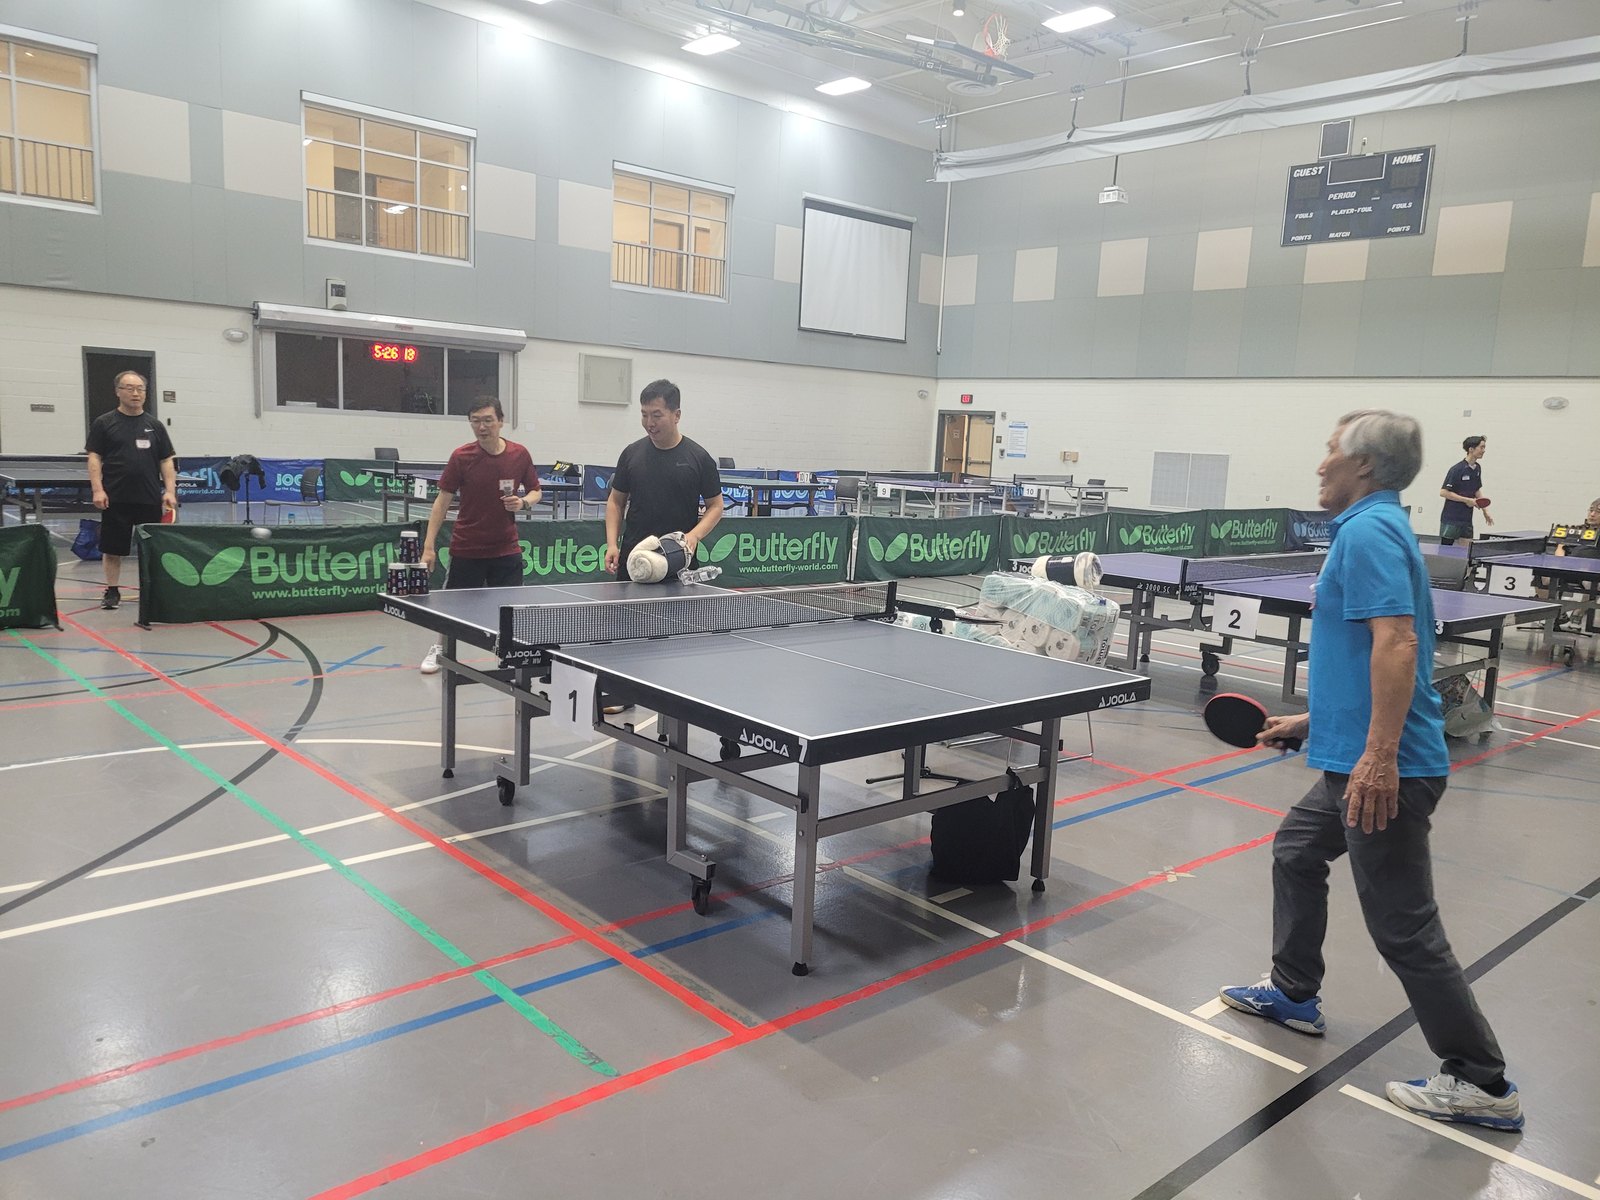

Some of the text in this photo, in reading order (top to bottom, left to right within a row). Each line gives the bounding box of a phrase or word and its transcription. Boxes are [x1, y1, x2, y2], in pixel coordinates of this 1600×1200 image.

[1392, 153, 1424, 165] HOME
[1293, 166, 1325, 178] GUEST
[1328, 191, 1356, 200] PERIOD
[1331, 206, 1372, 215] PLAYER-FOUL
[1387, 225, 1411, 233] POINTS
[881, 487, 887, 496] 9
[1026, 488, 1035, 496] 10
[1143, 522, 1196, 545] Butterfly
[1231, 519, 1278, 539] Butterfly
[1554, 527, 1567, 538] 5
[1583, 530, 1596, 540] 8
[738, 531, 839, 563] Butterfly
[910, 530, 991, 562] Butterfly
[1038, 527, 1097, 554] Butterfly
[518, 538, 608, 576] Butter
[738, 563, 839, 573] www.butterfly-world.com
[1019, 564, 1033, 574] JOO
[252, 583, 388, 599] www.butterfly-world
[1504, 576, 1516, 591] 3
[1228, 609, 1241, 630] 2
[512, 650, 542, 658] JOOLA
[568, 690, 578, 723] 1
[1106, 692, 1137, 707] JOOLA
[748, 733, 790, 758] JOOLA
